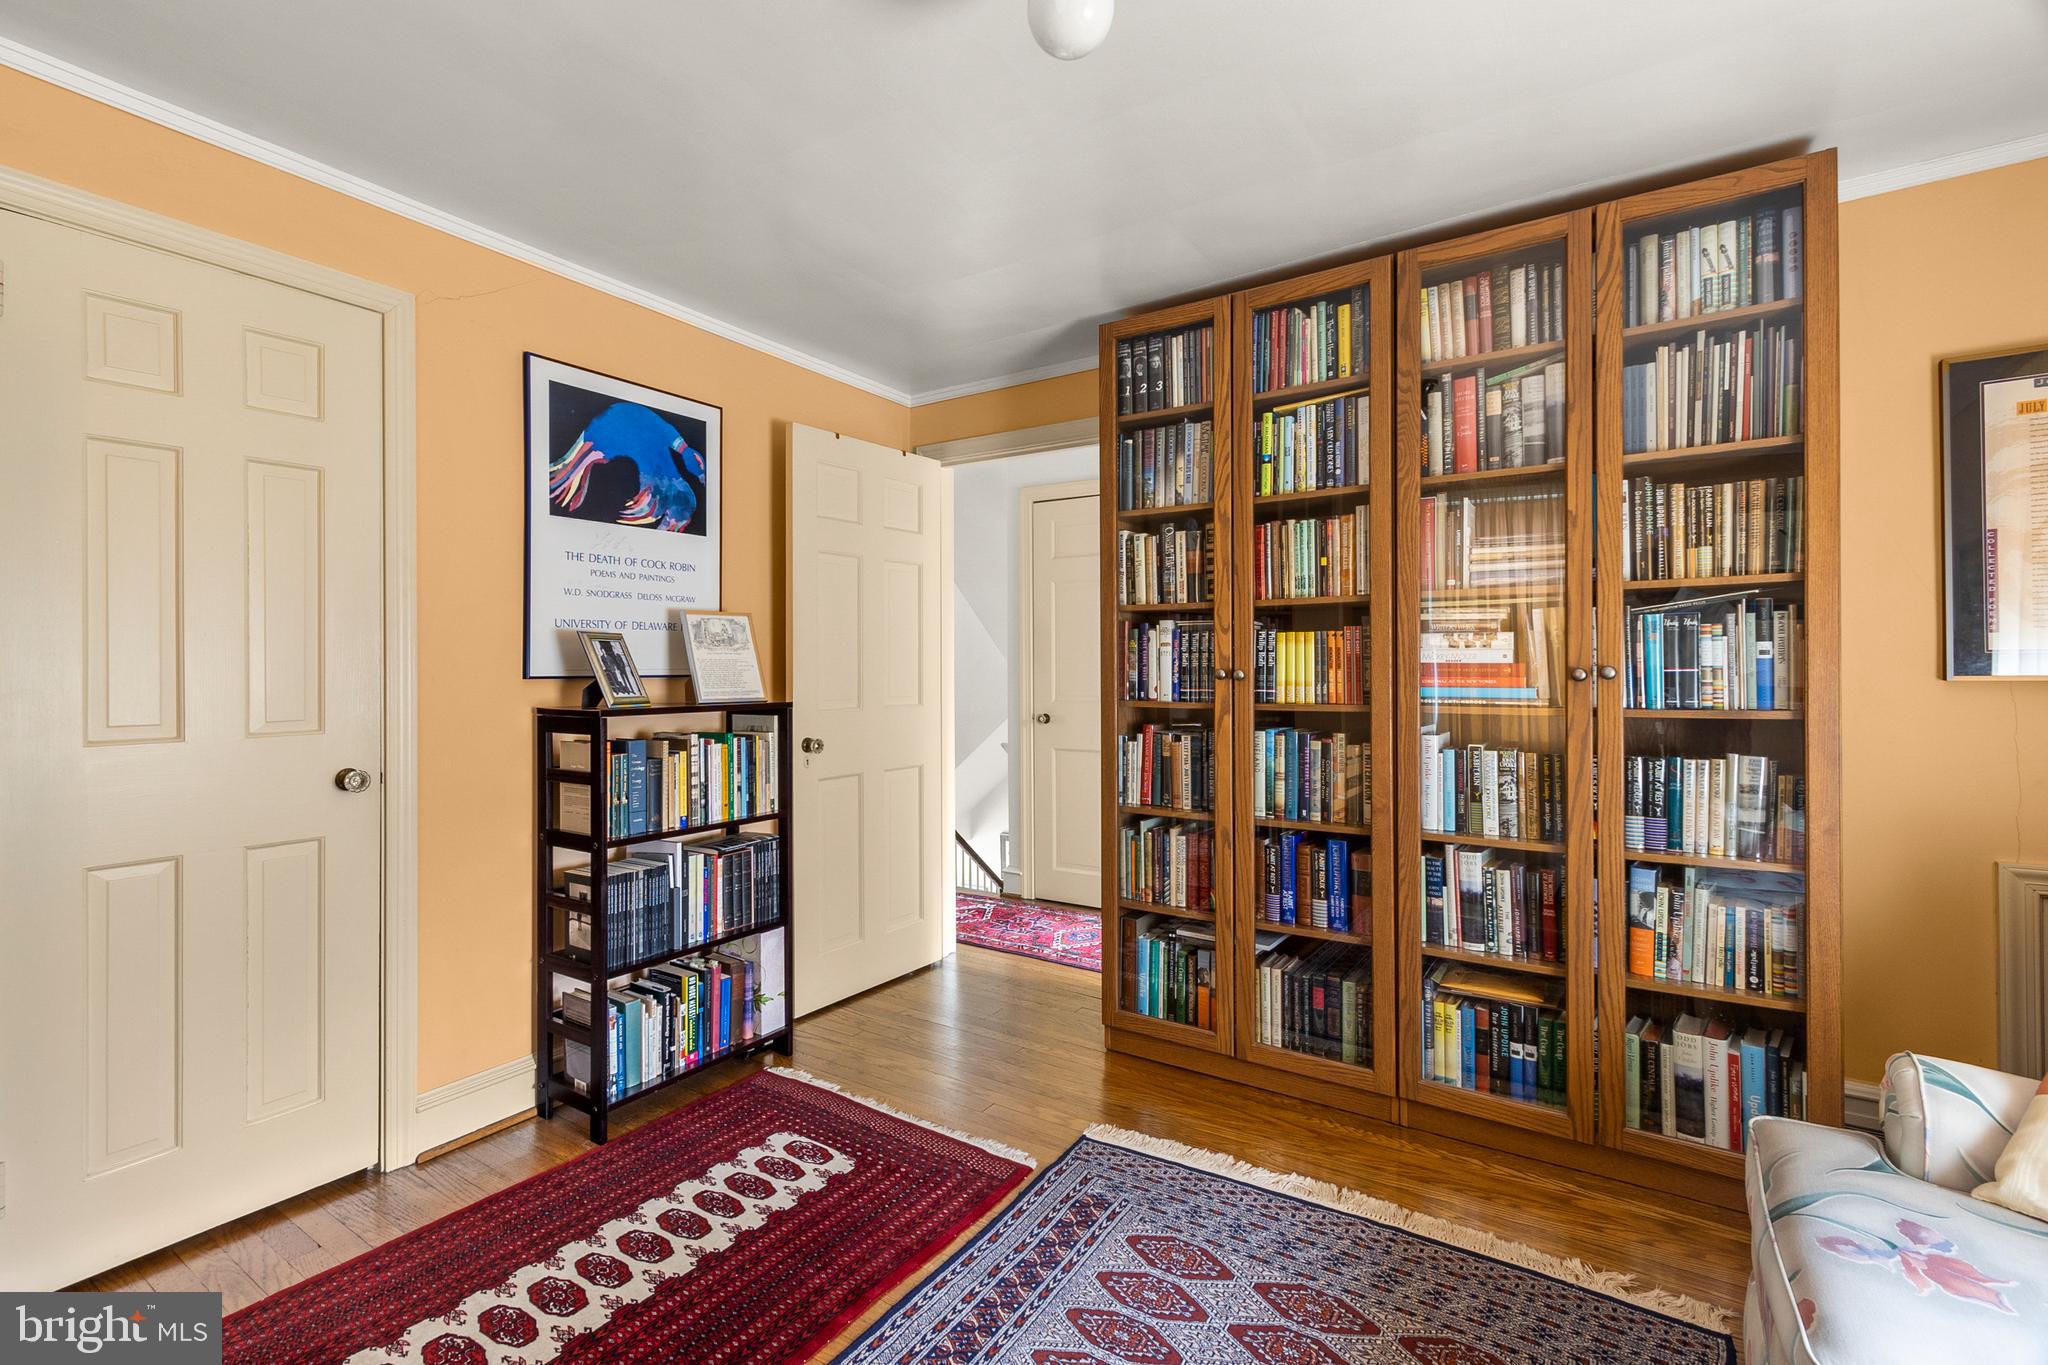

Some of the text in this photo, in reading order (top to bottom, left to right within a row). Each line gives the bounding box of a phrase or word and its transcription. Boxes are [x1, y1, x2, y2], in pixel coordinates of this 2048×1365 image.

[1125, 385, 1130, 396] 1
[1139, 383, 1148, 394] 2
[1155, 380, 1163, 391] 3
[2019, 400, 2045, 415] JULY
[1326, 426, 1334, 473] VERY OLD BONES
[1656, 489, 1664, 504] JOHN
[1645, 481, 1653, 535] JOHN UPDIKE
[1656, 505, 1664, 528] UPDIKE
[1705, 488, 1713, 528] RABBIT, RUN
[1776, 484, 1785, 530] THE CENTAUR
[565, 551, 696, 572] THE DEATH OF COCK ROBIN
[590, 569, 676, 583] POEMS AND PAINTINGS
[563, 587, 582, 597] W.D.
[586, 589, 633, 599] SNODGRASS
[637, 592, 663, 601] DELOSS
[554, 618, 678, 632] UNIVERSITY OF DELAWARE
[1181, 633, 1189, 652] Philip
[1257, 631, 1265, 667] Philip Roth
[1268, 631, 1276, 667] Philip Roth
[1424, 738, 1432, 754] John
[1655, 791, 1663, 805] REST
[1332, 845, 1341, 895] JOHN UPDIKE
[1670, 890, 1684, 939] John Updike
[688, 975, 697, 984] NO
[688, 986, 697, 999] MORE
[1501, 1006, 1509, 1057] JOHN UPDIKE
[1676, 1034, 1697, 1043] ODD
[1491, 1012, 1499, 1071] Due Considerations
[1648, 1046, 1656, 1059] THE
[1708, 1042, 1719, 1061] John
[1708, 1064, 1719, 1092] Updike
